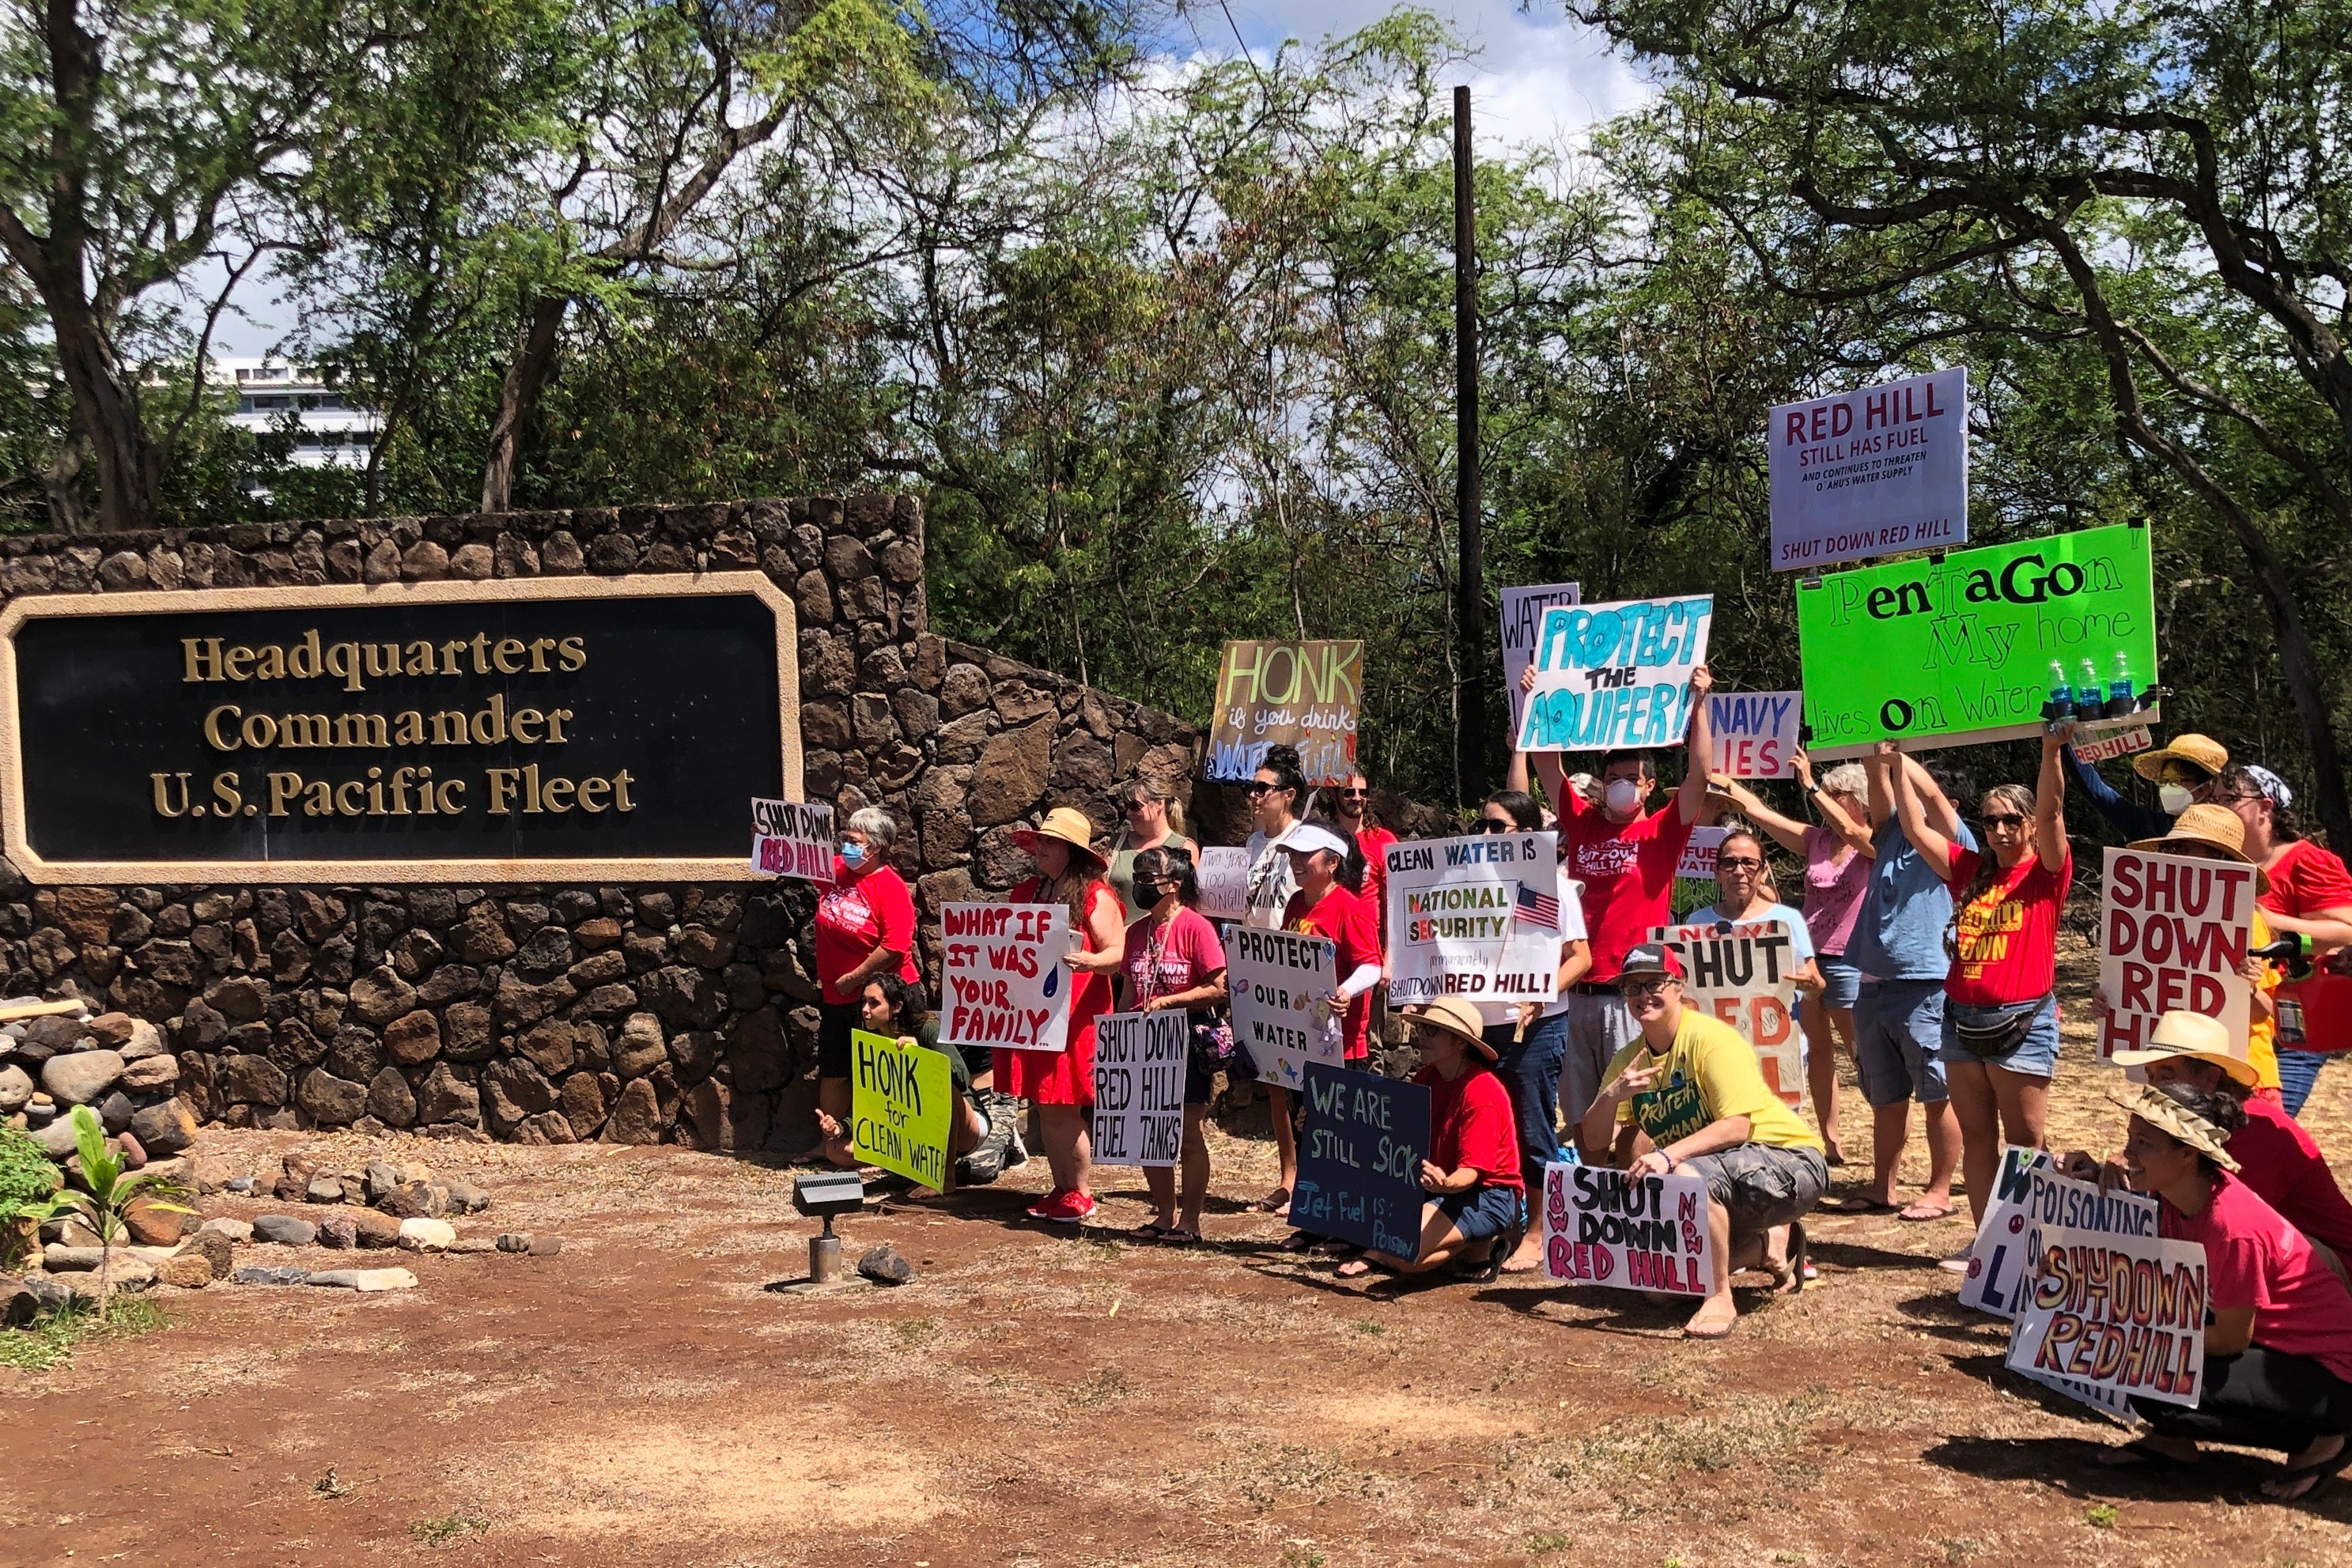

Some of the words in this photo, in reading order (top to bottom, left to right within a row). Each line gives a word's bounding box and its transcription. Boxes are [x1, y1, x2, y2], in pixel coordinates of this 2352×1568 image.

[1787, 402, 1853, 447] RED
[1866, 383, 1945, 431] HILL
[1799, 443, 1845, 467] STILL
[1850, 435, 1881, 458] HAS
[1887, 427, 1928, 451] FUEL
[1802, 471, 1821, 483] AND
[1822, 462, 1869, 479] CONTINUES
[1871, 459, 1882, 470] TO
[1884, 450, 1927, 467] THREATEN
[1852, 472, 1880, 486] WATER
[1881, 465, 1913, 480] SUPPLY
[1781, 539, 1821, 561] SHUT
[1825, 531, 1875, 554] DOWN
[1879, 525, 1910, 546] RED
[1915, 518, 1952, 540] HILL
[1538, 598, 1712, 671] PROTECT
[1922, 613, 2021, 670] My
[2036, 605, 2135, 650] home
[181, 629, 587, 691] Headquarters
[1225, 641, 1361, 706] HONK
[1585, 667, 1637, 690] THE
[204, 693, 573, 751] Commander
[1254, 709, 1296, 735] you
[1299, 704, 1356, 731] drink
[1521, 682, 1691, 749] AQUIFER!
[1711, 696, 1792, 738] NAVY
[1813, 699, 1871, 742] Lives
[1954, 676, 2042, 722] Water
[2074, 744, 2103, 761] RED
[2101, 733, 2150, 757] HILL
[151, 771, 259, 818] U.S.
[267, 766, 467, 817] Pacific
[486, 764, 636, 814] Fleet
[756, 801, 800, 839] SHUT
[759, 838, 794, 874] RED
[796, 842, 832, 880] HILL
[1203, 851, 1222, 868] TWO
[1224, 850, 1248, 871] YEARS
[1387, 847, 1435, 873] CLEAN
[1444, 841, 1514, 866] WATER
[1522, 837, 1537, 860] IS
[1684, 846, 1718, 859] FUE
[1204, 872, 1227, 889] TOO
[1408, 887, 1508, 914] NATIONAL
[2111, 855, 2251, 921] SHUT
[944, 908, 1013, 937] WHAT
[1015, 910, 1052, 944] IF
[1409, 916, 1506, 942] SECURITY
[2109, 909, 2248, 976] DOWN
[947, 943, 980, 968] IT
[987, 944, 1038, 979] WAS
[1238, 930, 1322, 972] PROTECT
[950, 974, 1010, 1011] YOUR
[1254, 984, 1289, 1010] OUR
[1445, 973, 1486, 994] RED
[1492, 973, 1551, 994] HILL!
[2121, 962, 2226, 1018] RED
[1097, 1017, 1139, 1063] SHUT
[1144, 1015, 1185, 1061] DOWN
[1253, 1021, 1307, 1052] WATER
[1682, 996, 1791, 1045] ED
[858, 1041, 921, 1116] HONK
[1096, 1067, 1132, 1111] RED
[1140, 1066, 1182, 1112] HILL
[884, 1100, 909, 1129] for
[1310, 1075, 1347, 1121] WE
[1352, 1087, 1393, 1132] ARE
[856, 1117, 902, 1162] CLEAN
[1094, 1115, 1127, 1158] FUEL
[1140, 1115, 1182, 1161] TANKS
[1311, 1128, 1360, 1169] STILL
[1372, 1135, 1418, 1190] SICK
[1297, 1181, 1333, 1221] Jet
[1338, 1192, 1366, 1223] Fuel
[1547, 1169, 1569, 1233] NOW
[1571, 1166, 1664, 1219] SHUT
[2031, 1174, 2153, 1238] POISONING
[1579, 1212, 1677, 1253] DOWN
[1678, 1192, 1703, 1255] NOW
[1548, 1234, 1615, 1281] RED
[1627, 1249, 1706, 1294] HILL
